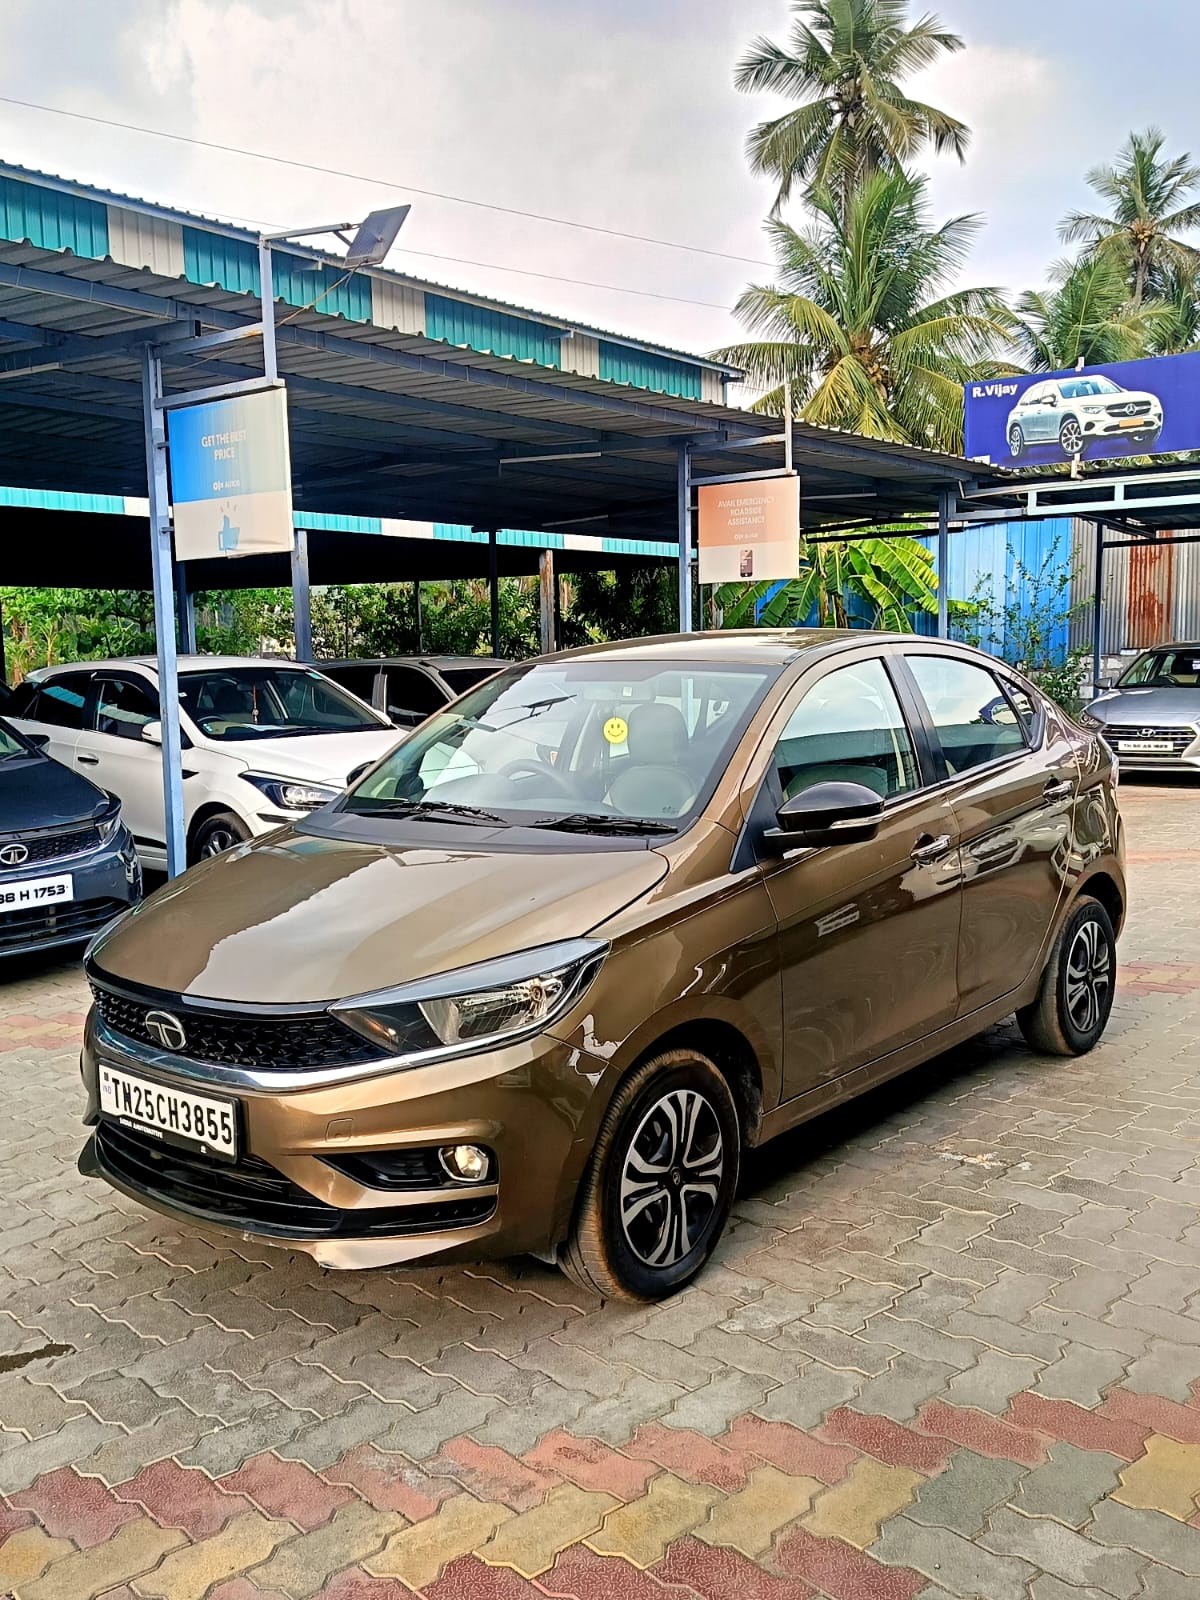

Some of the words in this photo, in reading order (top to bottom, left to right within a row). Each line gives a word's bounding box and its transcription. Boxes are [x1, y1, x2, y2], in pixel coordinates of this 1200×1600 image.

[972, 384, 1018, 398] R.Vijay
[201, 435, 215, 448] GET
[216, 432, 230, 446] THE
[214, 446, 235, 461] PRICE
[718, 499, 736, 508] AVAIL
[727, 515, 765, 526] ASSISTANCE
[20, 890, 30, 901] H
[34, 884, 66, 899] 1753
[111, 1077, 233, 1145] TN25CH3855
